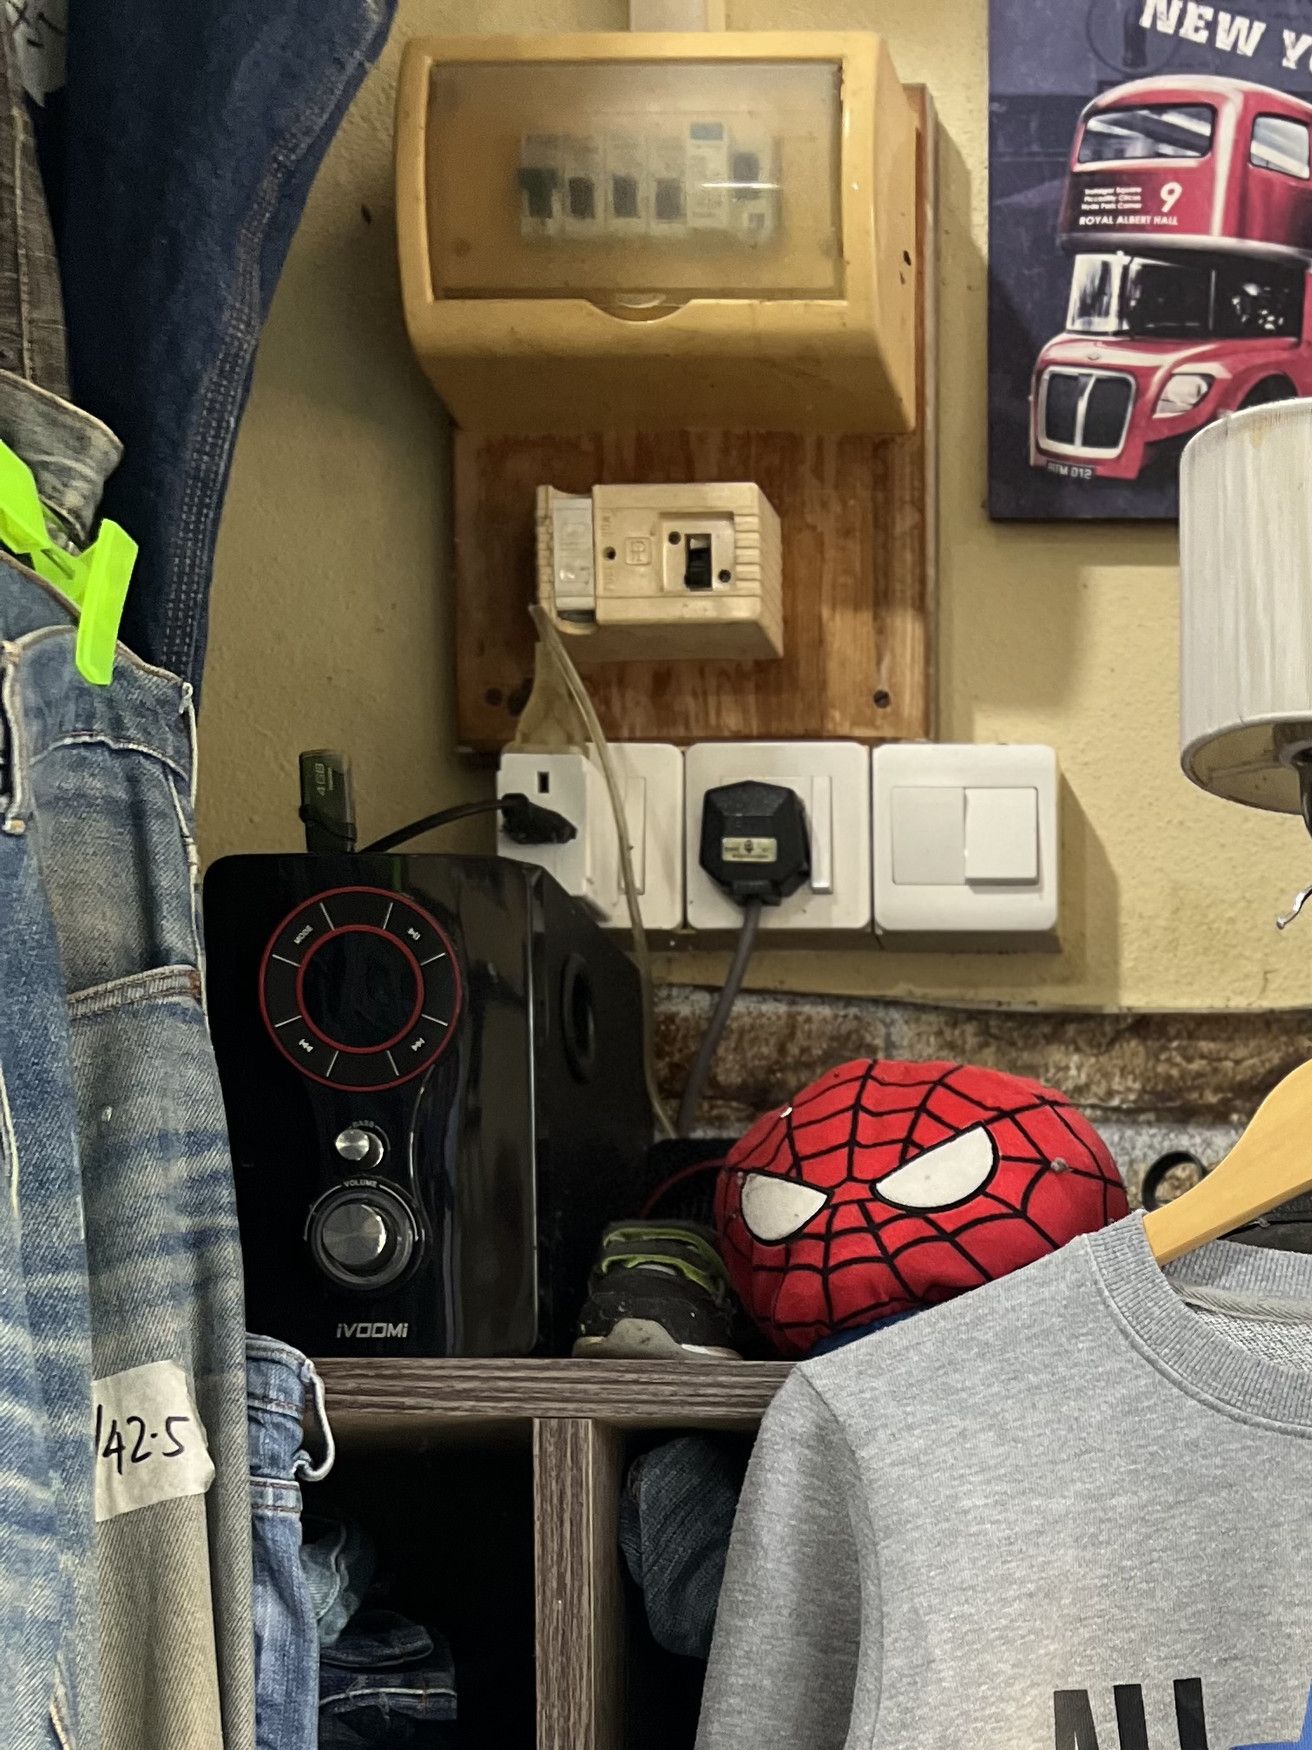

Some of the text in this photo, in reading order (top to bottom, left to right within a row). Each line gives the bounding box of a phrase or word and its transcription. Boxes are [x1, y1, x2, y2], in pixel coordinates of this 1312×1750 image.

[1139, 0, 1266, 57] NEW
[1160, 182, 1182, 213] 9
[1079, 215, 1178, 226] ROYAL ALBERT HALL
[343, 1179, 378, 1188] VOLUME
